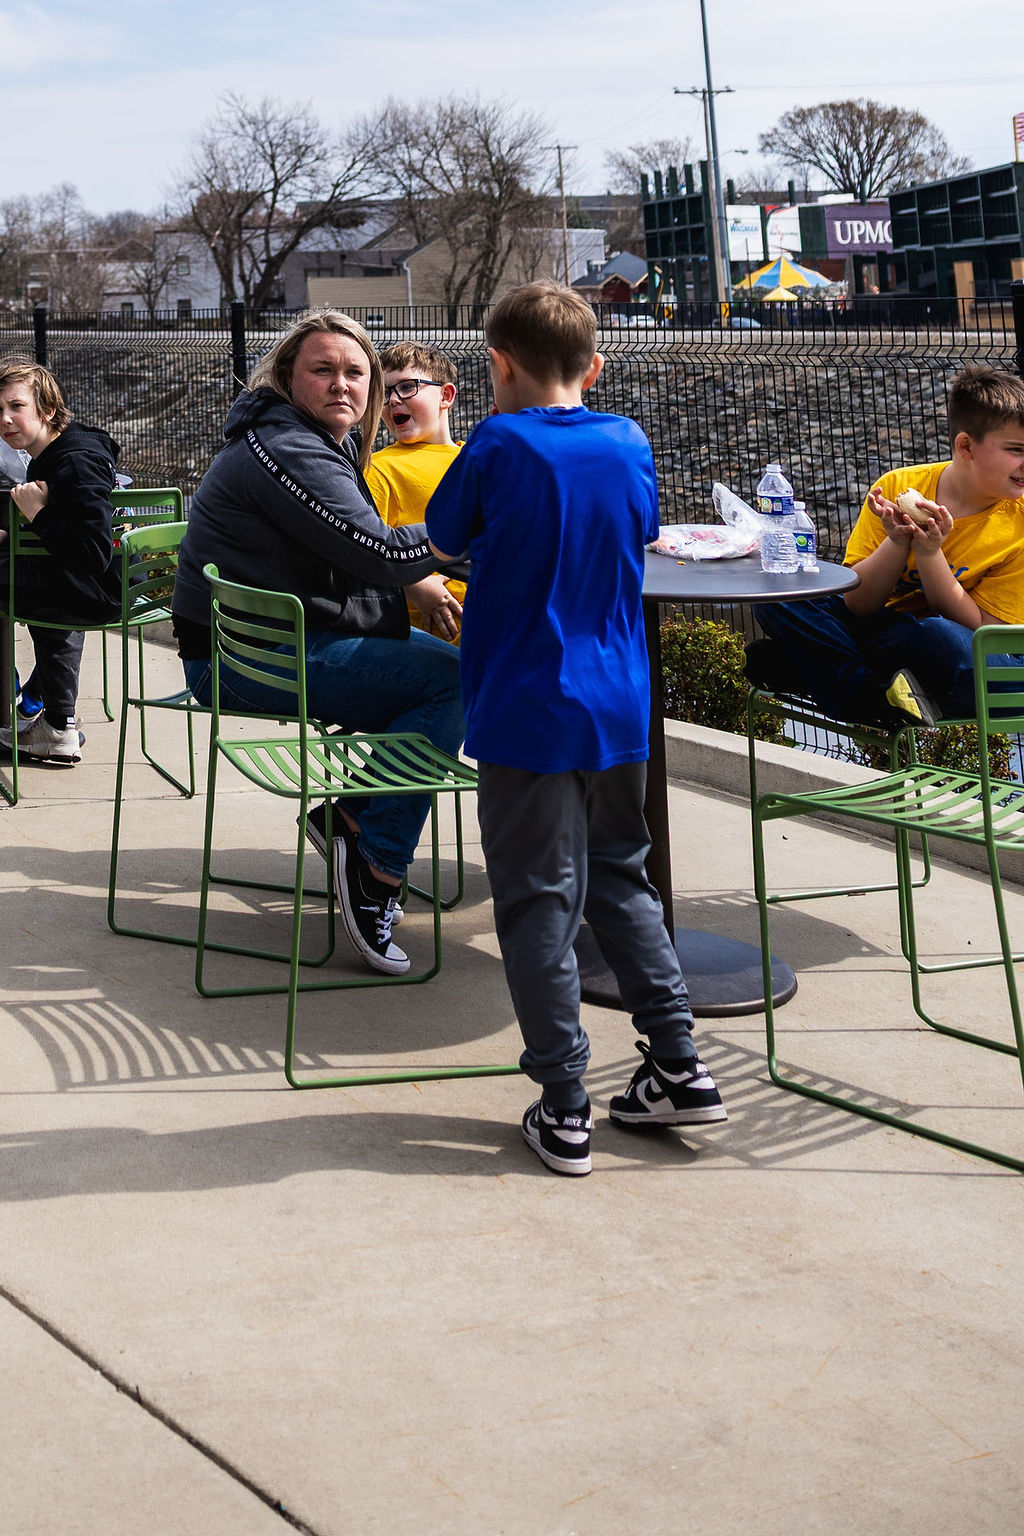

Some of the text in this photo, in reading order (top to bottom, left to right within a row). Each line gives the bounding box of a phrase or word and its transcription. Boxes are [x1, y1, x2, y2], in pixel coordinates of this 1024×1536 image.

[834, 220, 893, 245] UPMC
[252, 442, 278, 473] ARMOUR
[280, 474, 308, 501] UNDER
[309, 500, 348, 532] ARMOUR
[353, 531, 386, 554] UNDER
[385, 545, 429, 560] ARMOUR
[562, 1116, 583, 1127] NIKE
